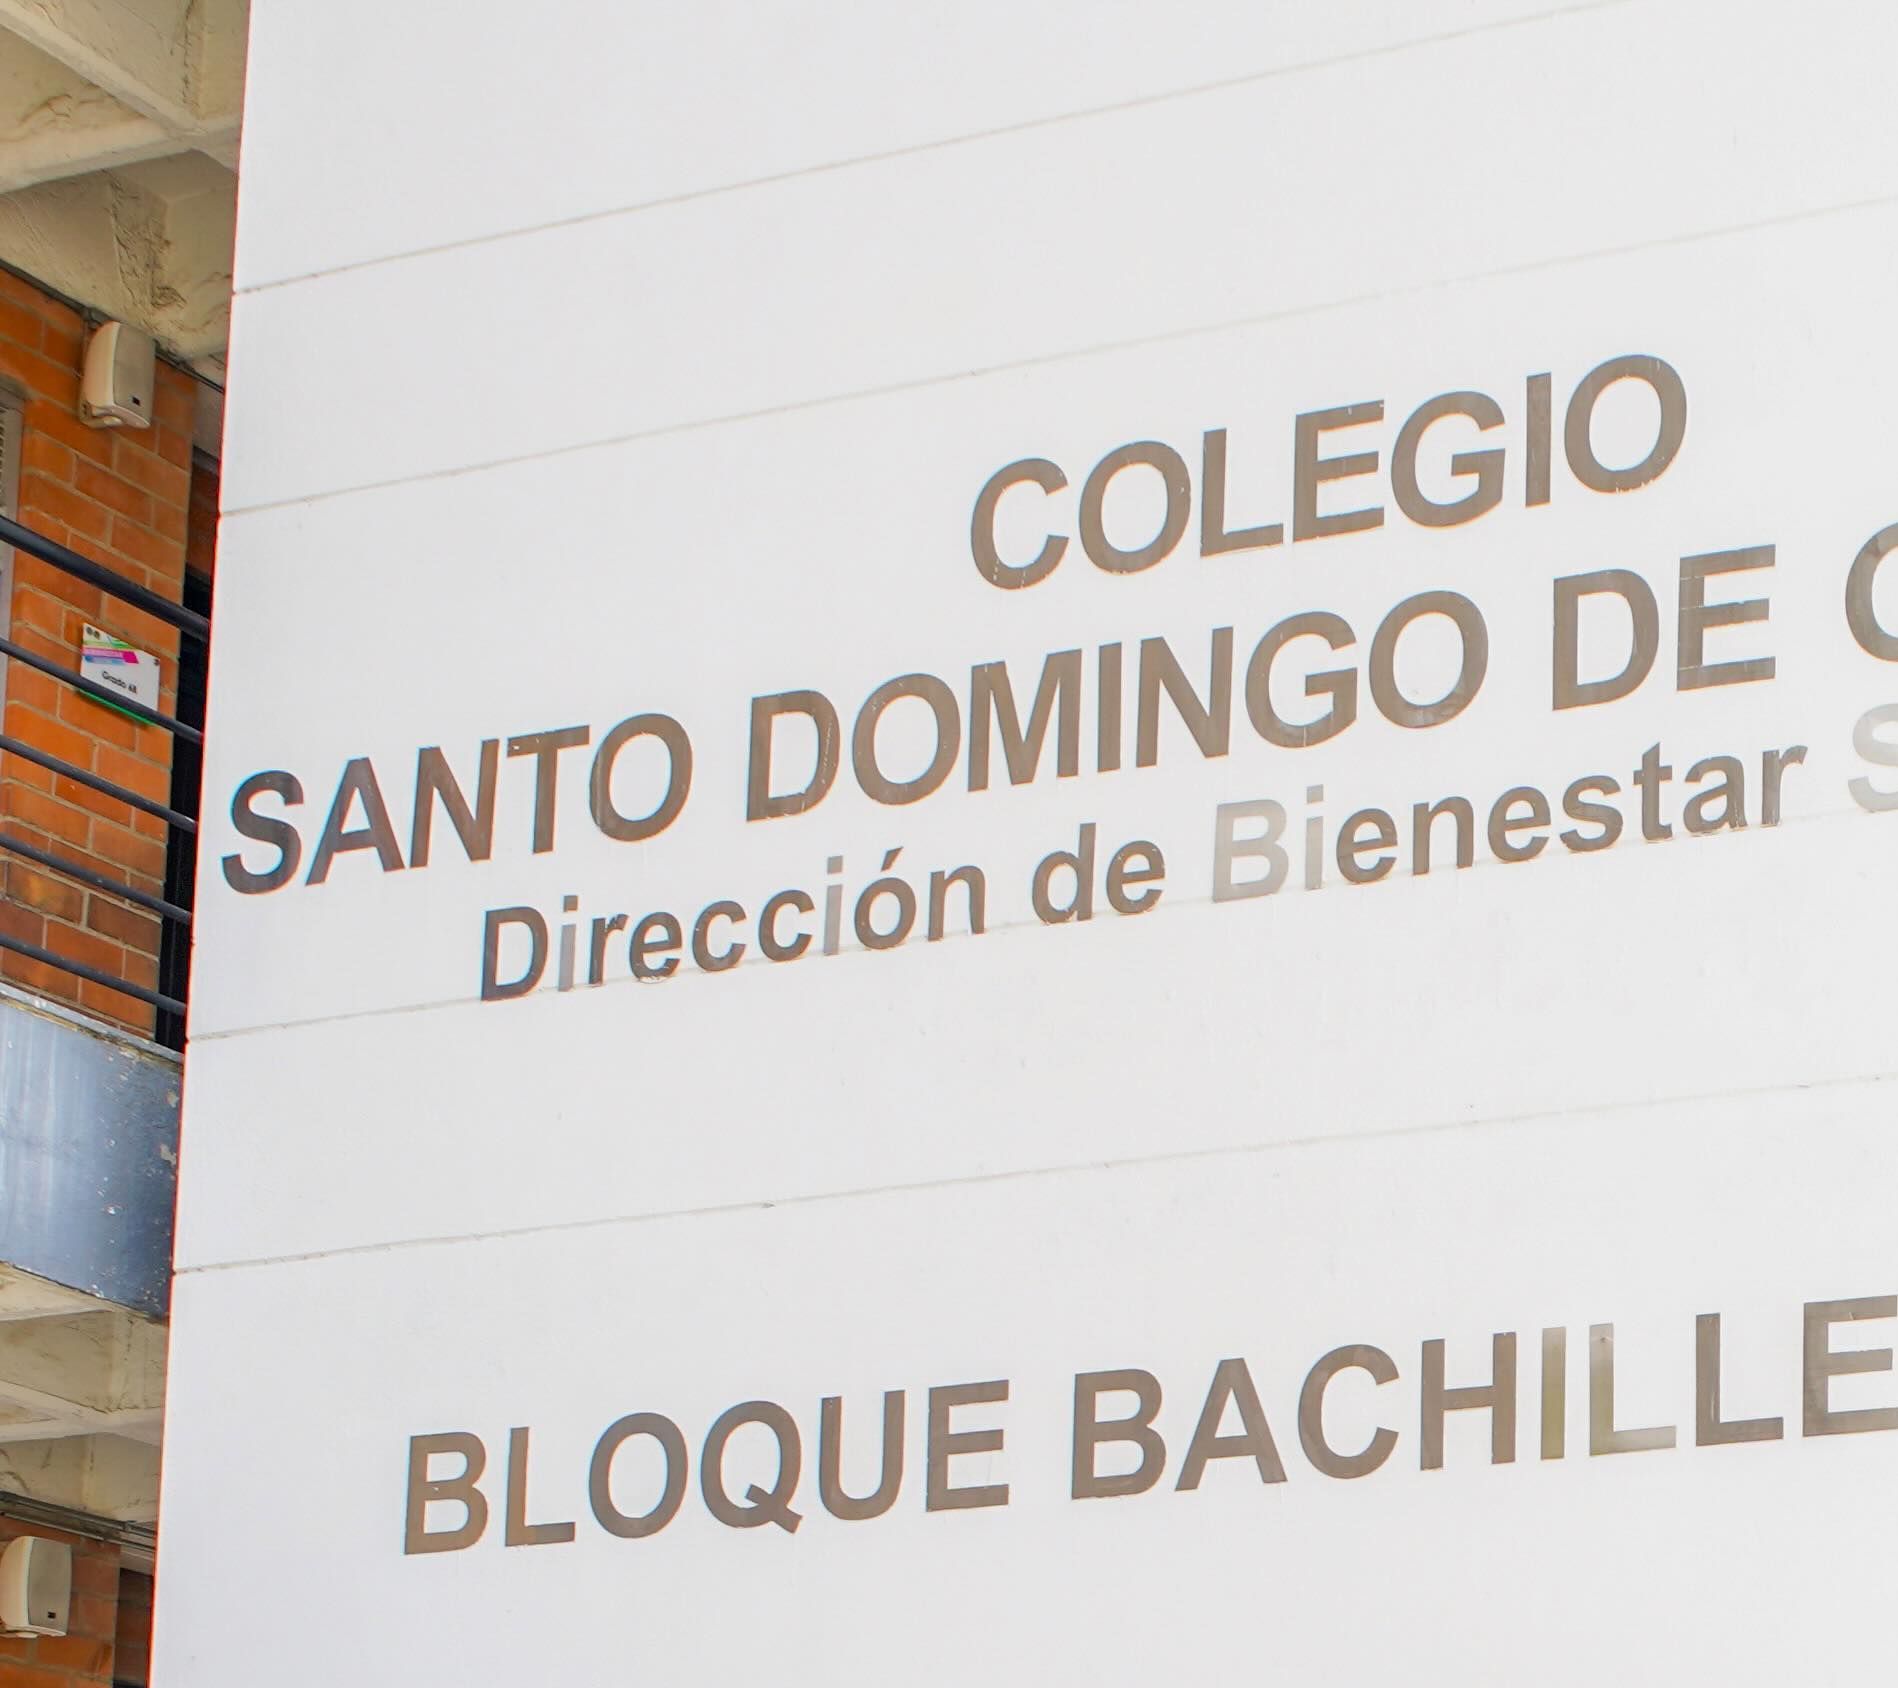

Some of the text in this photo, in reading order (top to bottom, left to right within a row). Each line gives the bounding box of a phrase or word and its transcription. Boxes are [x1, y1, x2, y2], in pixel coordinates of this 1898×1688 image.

[970, 354, 1687, 591] COLEGIO
[221, 713, 693, 896] SANTO
[746, 590, 1488, 823] DOMINGO
[1552, 544, 1777, 712] DE
[481, 846, 988, 1002] Dirección
[1032, 822, 1166, 927] de
[1211, 741, 1809, 905] Bienestar
[403, 1294, 1898, 1556] BLOQUE BACHILLE
